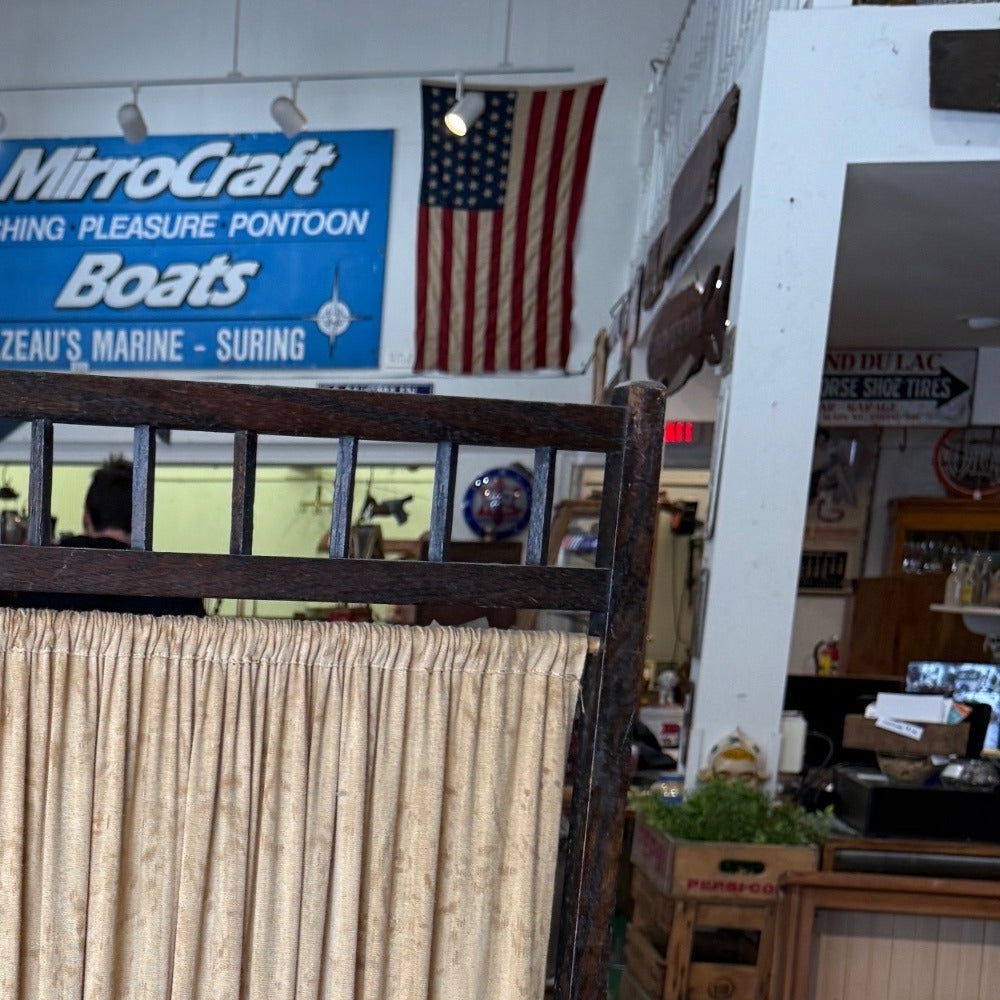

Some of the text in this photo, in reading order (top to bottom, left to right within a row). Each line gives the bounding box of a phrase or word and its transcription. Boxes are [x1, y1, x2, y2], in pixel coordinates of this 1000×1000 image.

[77, 212, 218, 240] PLEASURE
[228, 209, 370, 238] PONTOON
[54, 252, 260, 309] Boats
[92, 328, 184, 361] MARINE
[217, 327, 305, 360] SURING
[826, 352, 943, 370] ND DU LAC
[822, 377, 951, 398] ORSE SHOE TIRES
[687, 878, 779, 895] PEPSI-CO
